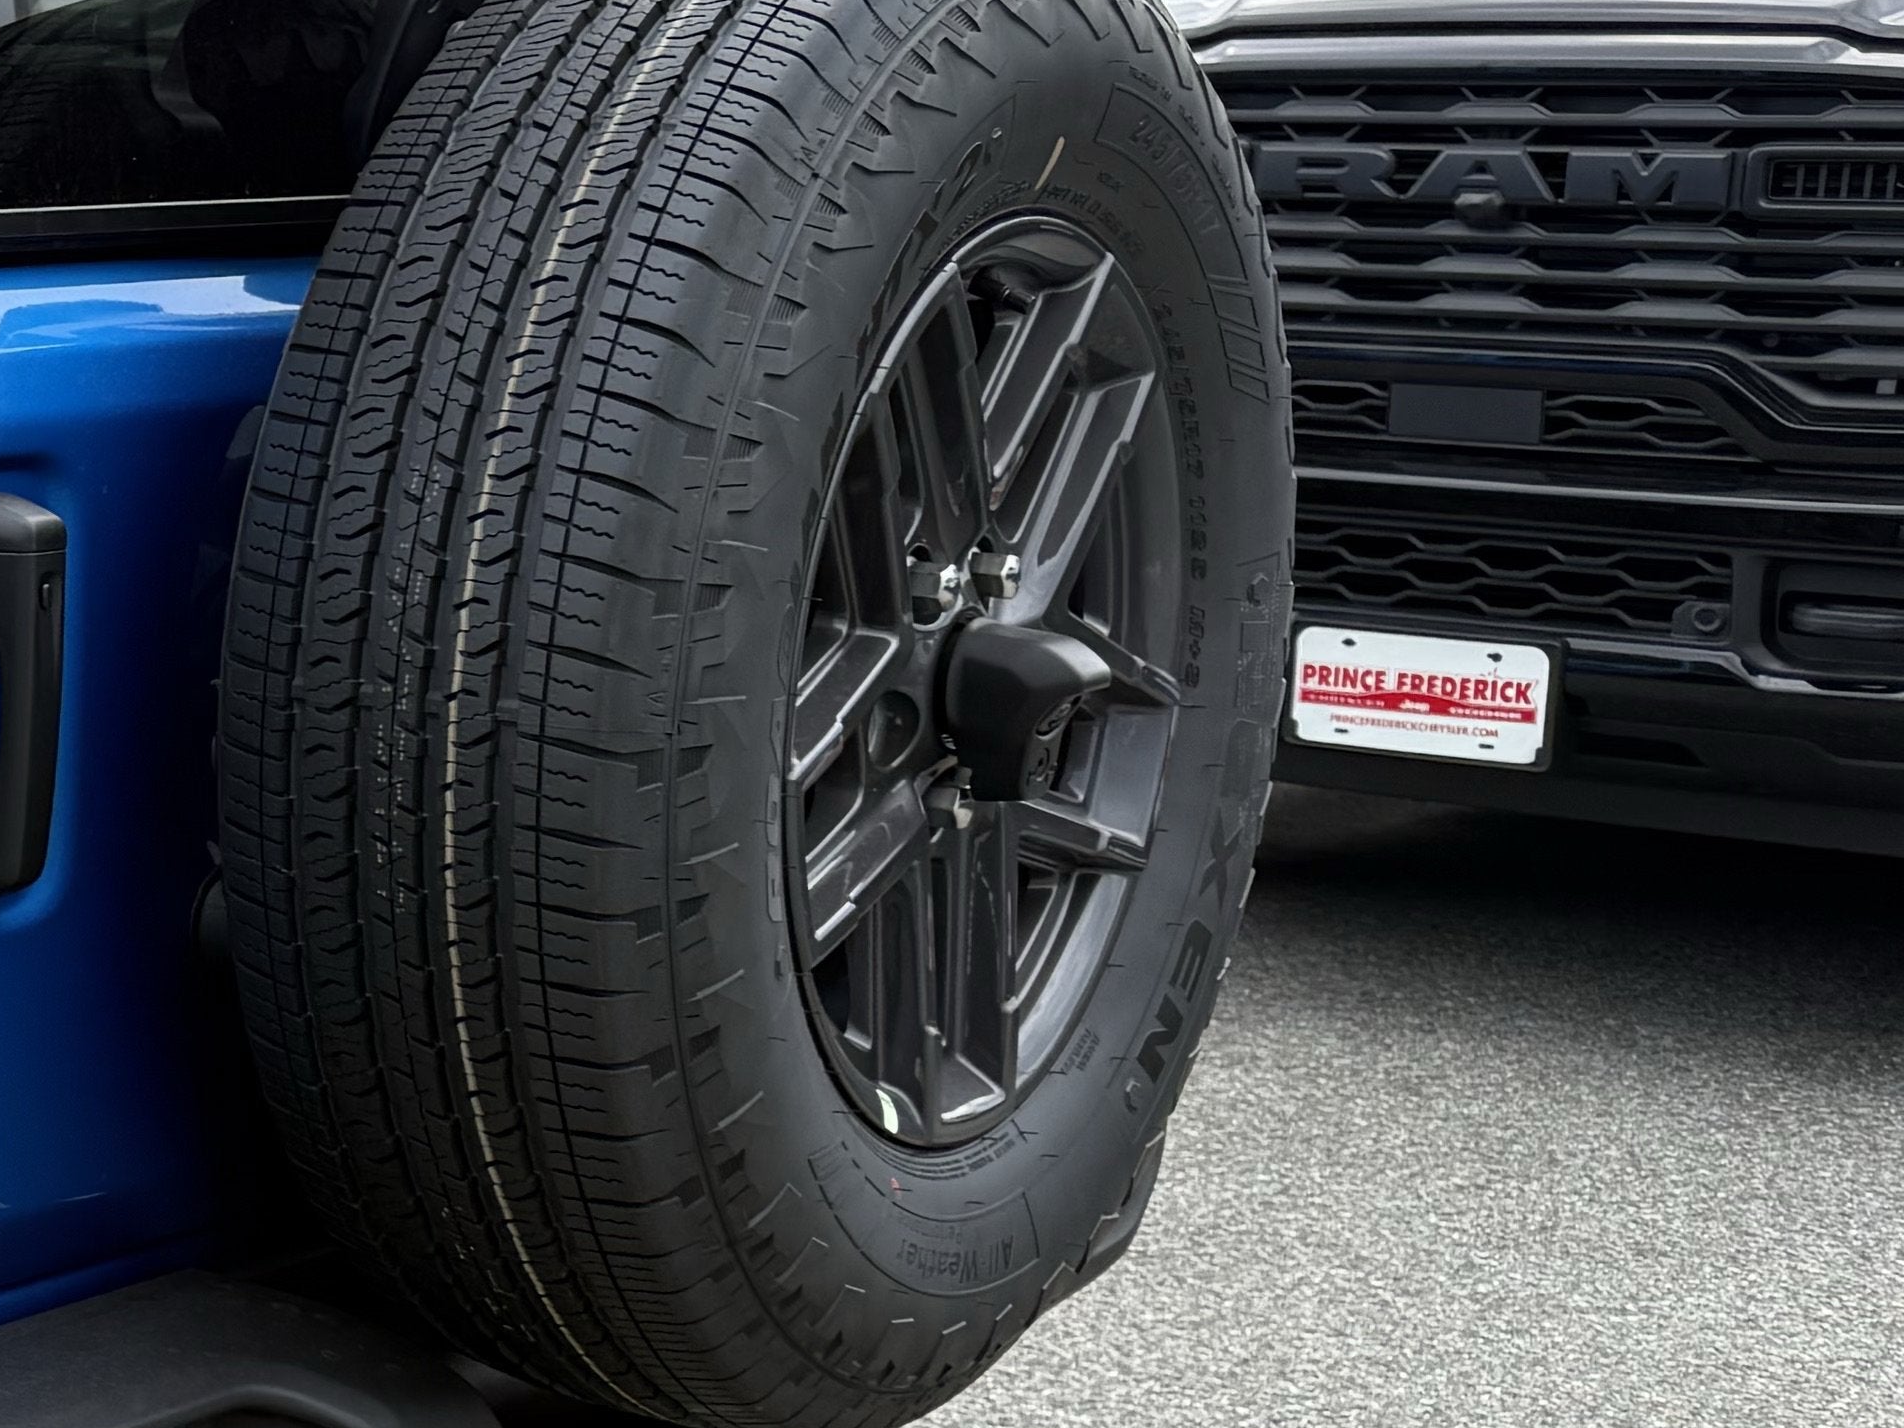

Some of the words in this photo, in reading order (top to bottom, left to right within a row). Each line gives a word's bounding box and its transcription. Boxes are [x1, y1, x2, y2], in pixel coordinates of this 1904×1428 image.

[1255, 142, 1733, 208] RAM
[1302, 663, 1387, 692] PRINCE
[1396, 671, 1532, 705] FREDERICK
